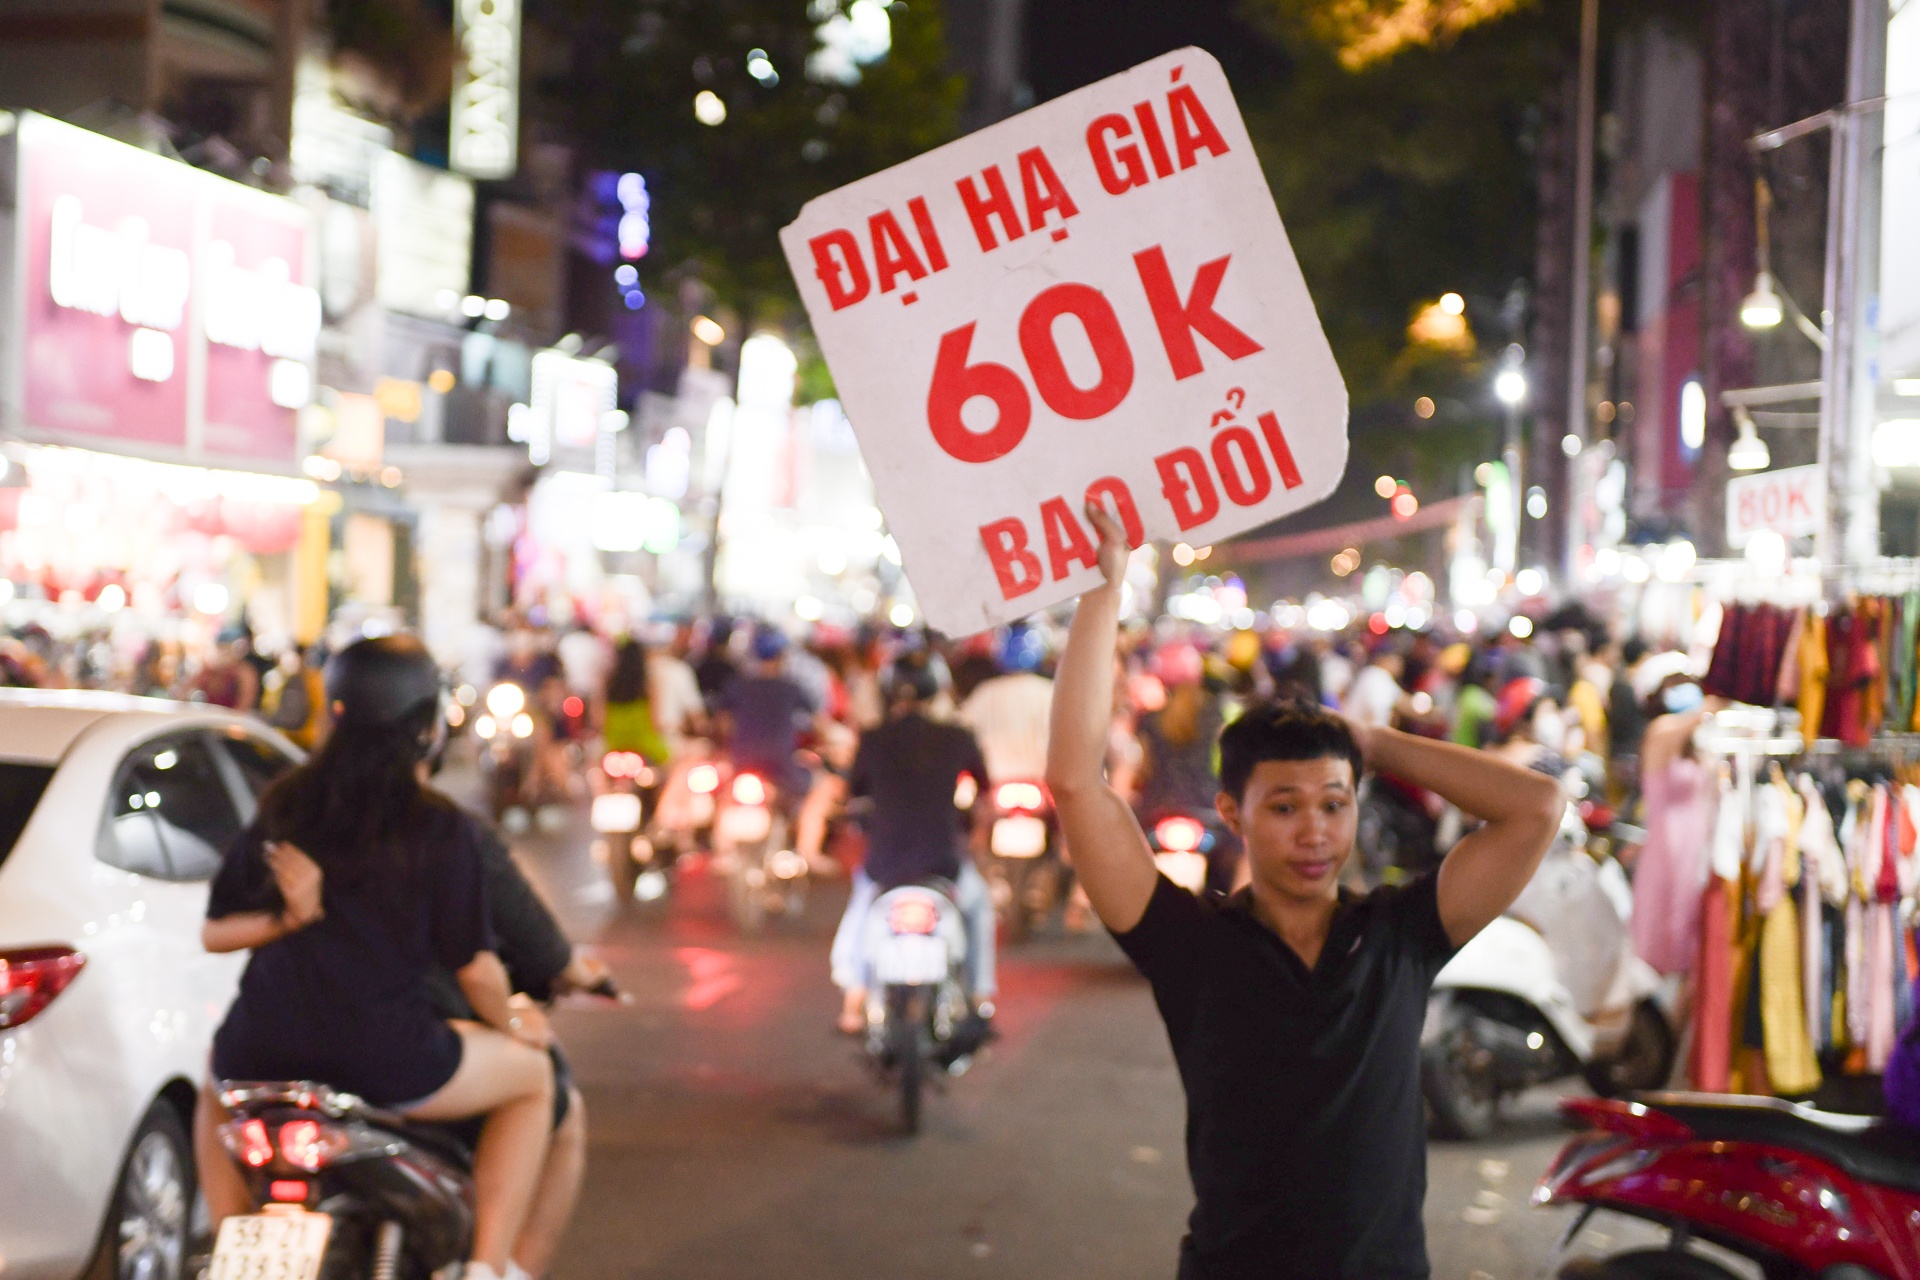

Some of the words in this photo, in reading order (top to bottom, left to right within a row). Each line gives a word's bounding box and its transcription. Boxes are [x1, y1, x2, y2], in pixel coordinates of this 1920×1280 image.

[807, 195, 950, 312] ĐẠI
[955, 146, 1081, 254] HẠ
[1085, 66, 1231, 196] GIÁ
[979, 477, 1145, 602] BAO
[1153, 387, 1304, 533] ĐỔI
